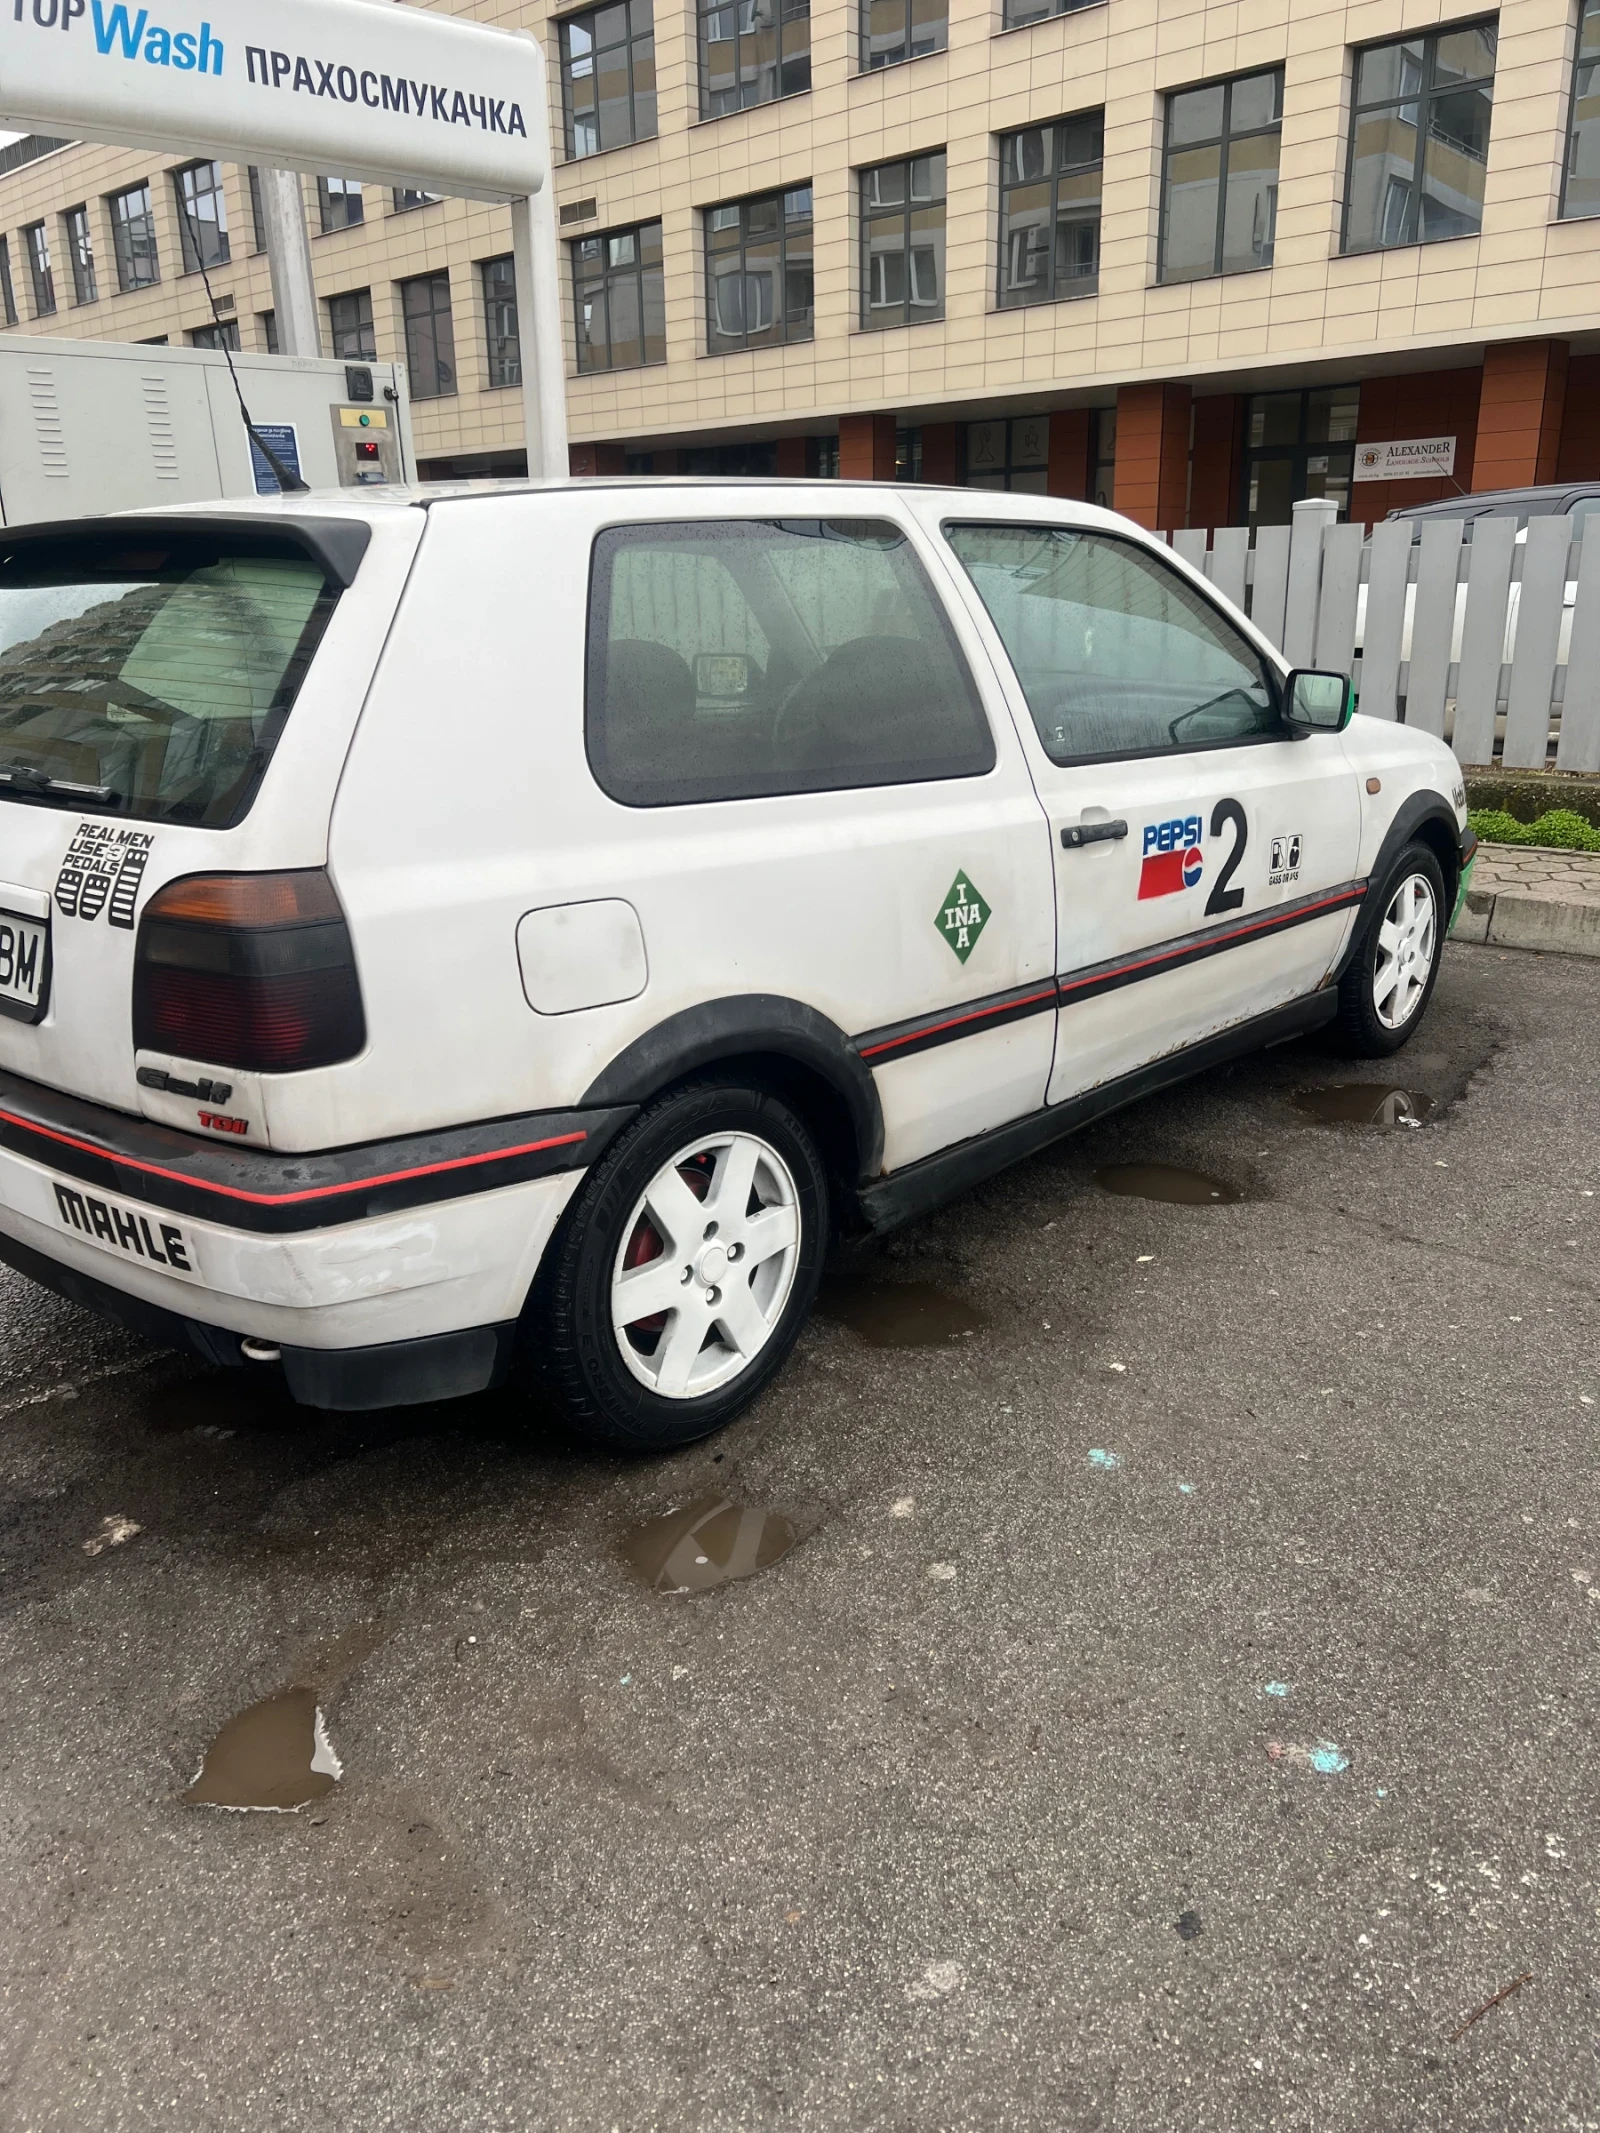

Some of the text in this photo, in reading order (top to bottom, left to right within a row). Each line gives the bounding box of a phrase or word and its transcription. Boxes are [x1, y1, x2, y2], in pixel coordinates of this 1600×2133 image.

[91, 0, 225, 76] Wash
[245, 45, 528, 138] ПРАХОСМУКАЧКА
[1387, 442, 1450, 457] ALEXANDER
[68, 838, 127, 862] USE 3
[76, 823, 155, 849] REAL MEN
[1142, 815, 1202, 856] PEPSI
[62, 853, 120, 876] PEDALS
[1204, 798, 1248, 917] 2
[944, 903, 982, 930] INA
[52, 1182, 192, 1272] MAHLE
